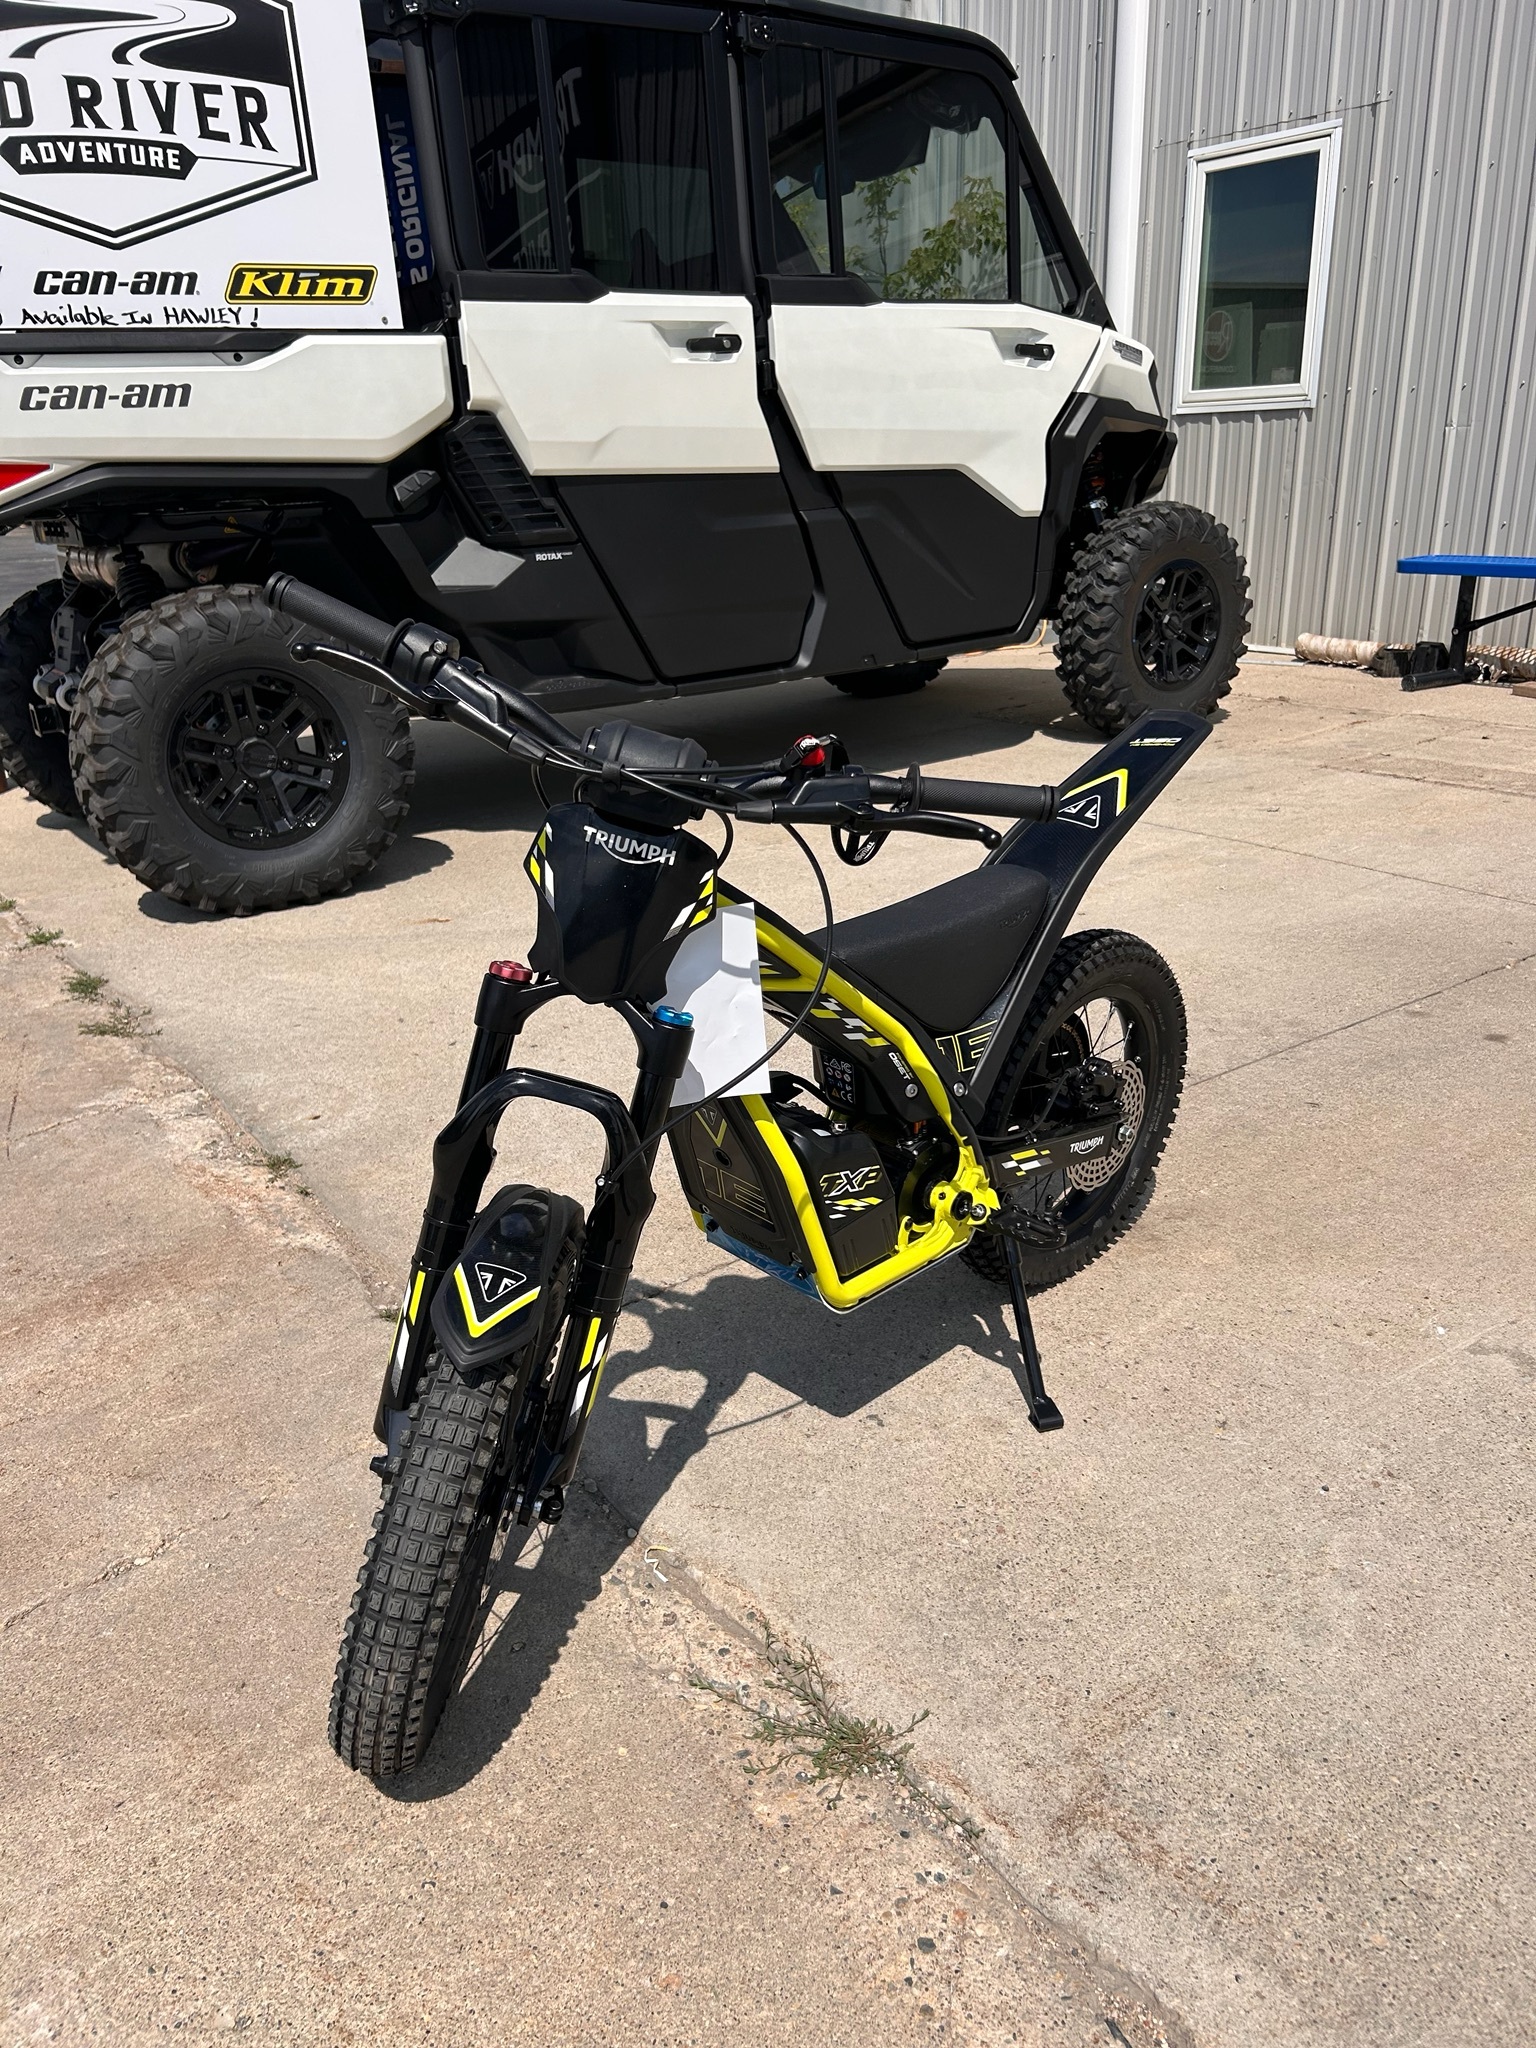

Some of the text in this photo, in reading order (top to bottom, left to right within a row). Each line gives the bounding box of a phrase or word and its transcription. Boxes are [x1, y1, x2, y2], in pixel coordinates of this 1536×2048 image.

[61, 74, 279, 153] RIVER
[20, 142, 181, 170] ADVENTURE
[33, 270, 199, 295] can-am
[21, 303, 119, 326] Available
[163, 306, 242, 325] HAWLEY
[19, 383, 193, 412] can-am
[535, 552, 562, 561] ROTAX
[583, 825, 676, 866] TRIUMPH
[888, 1051, 911, 1081] OSET
[1069, 1135, 1104, 1154] TRIUMPH
[820, 1165, 883, 1198] TXP
